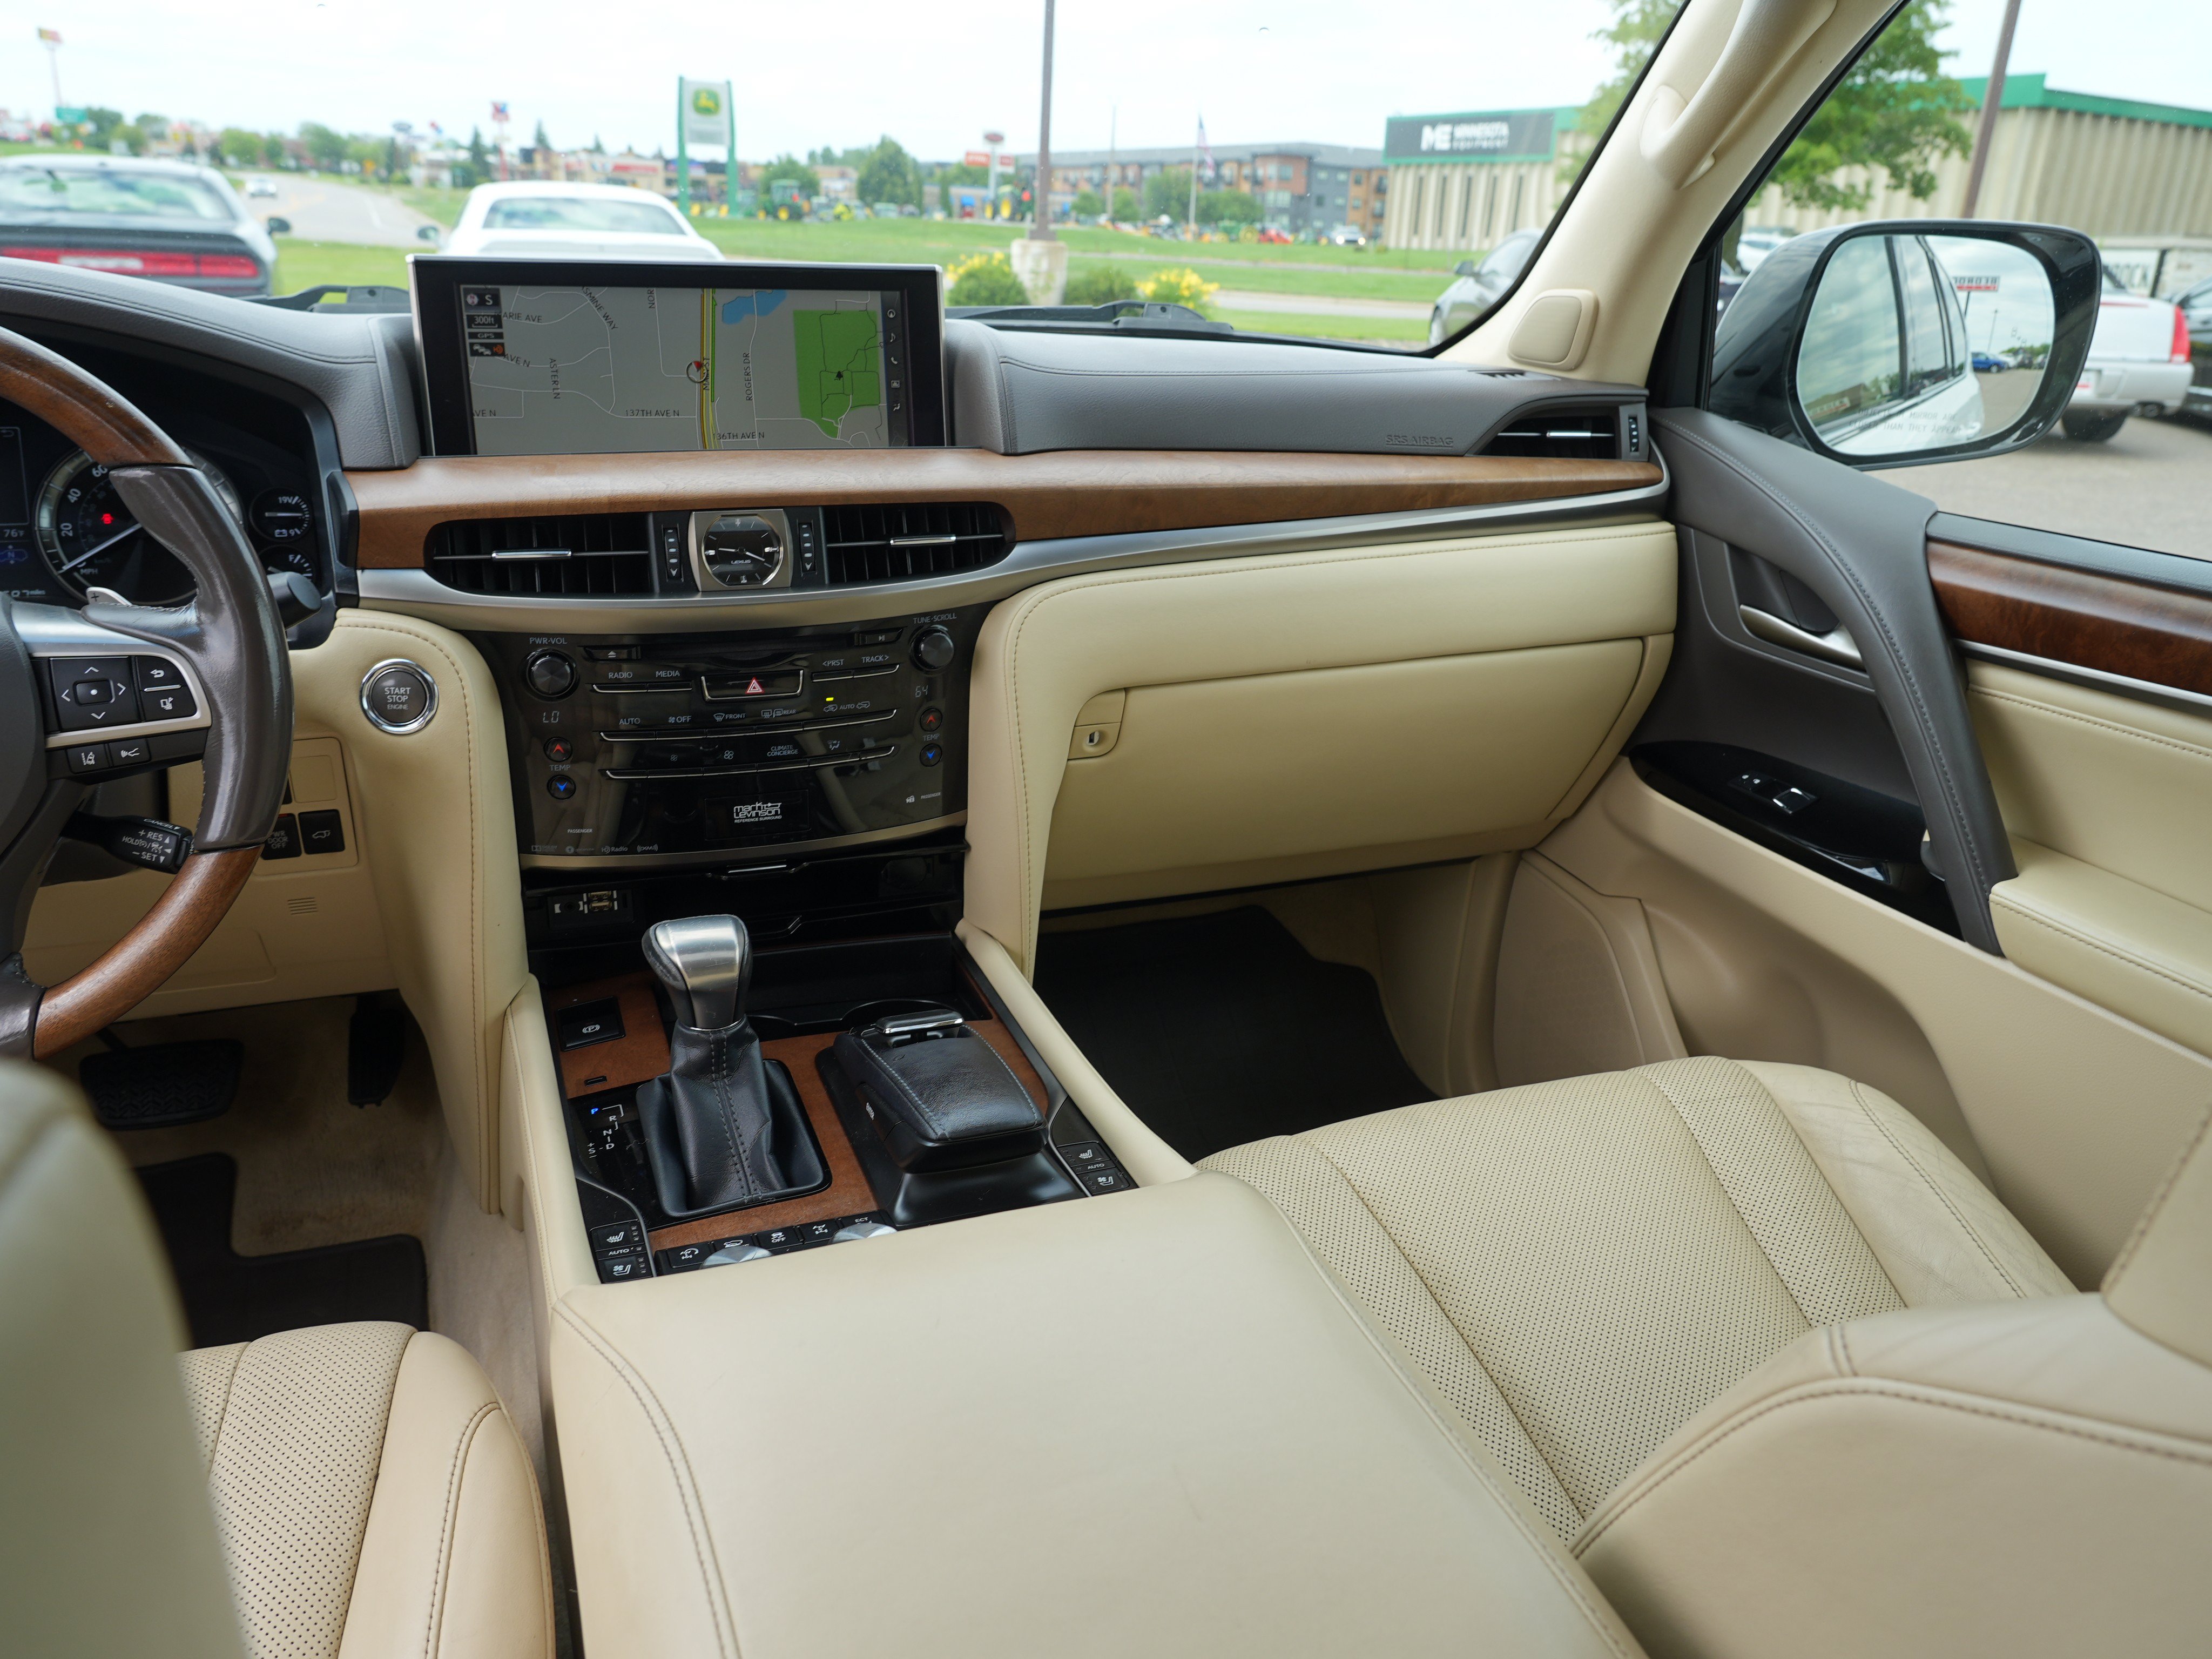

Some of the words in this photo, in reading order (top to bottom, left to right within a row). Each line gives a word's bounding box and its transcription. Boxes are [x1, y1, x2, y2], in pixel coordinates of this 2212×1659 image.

[485, 294, 493, 305] S
[474, 316, 494, 324] 300ft
[525, 315, 542, 323] AVE
[603, 312, 618, 329] WAY
[503, 353, 521, 365] AVE
[523, 360, 530, 368] N
[743, 352, 750, 364] DR
[549, 358, 559, 385] ASTER
[744, 366, 753, 401] ROGERS
[552, 388, 561, 399] LN
[1884, 423, 1903, 431] THAN
[1908, 424, 1927, 433] THEY
[1386, 435, 1407, 443] SRS
[1412, 436, 1453, 445] AIRBAG
[67, 488, 82, 503] 40
[60, 522, 73, 537] 20
[861, 654, 884, 663] TRACK
[609, 671, 633, 679] RADIO
[656, 670, 680, 678] MEDIA
[385, 687, 411, 695] START
[915, 684, 929, 698] 64
[387, 694, 409, 703] STOP
[619, 717, 640, 725] AUTO
[922, 733, 940, 742] TEMP
[767, 749, 799, 757] CONCIERGE
[144, 818, 174, 829] CANCEL
[122, 835, 139, 846] HOLD
[147, 831, 163, 841] RES
[141, 851, 158, 861] SET
